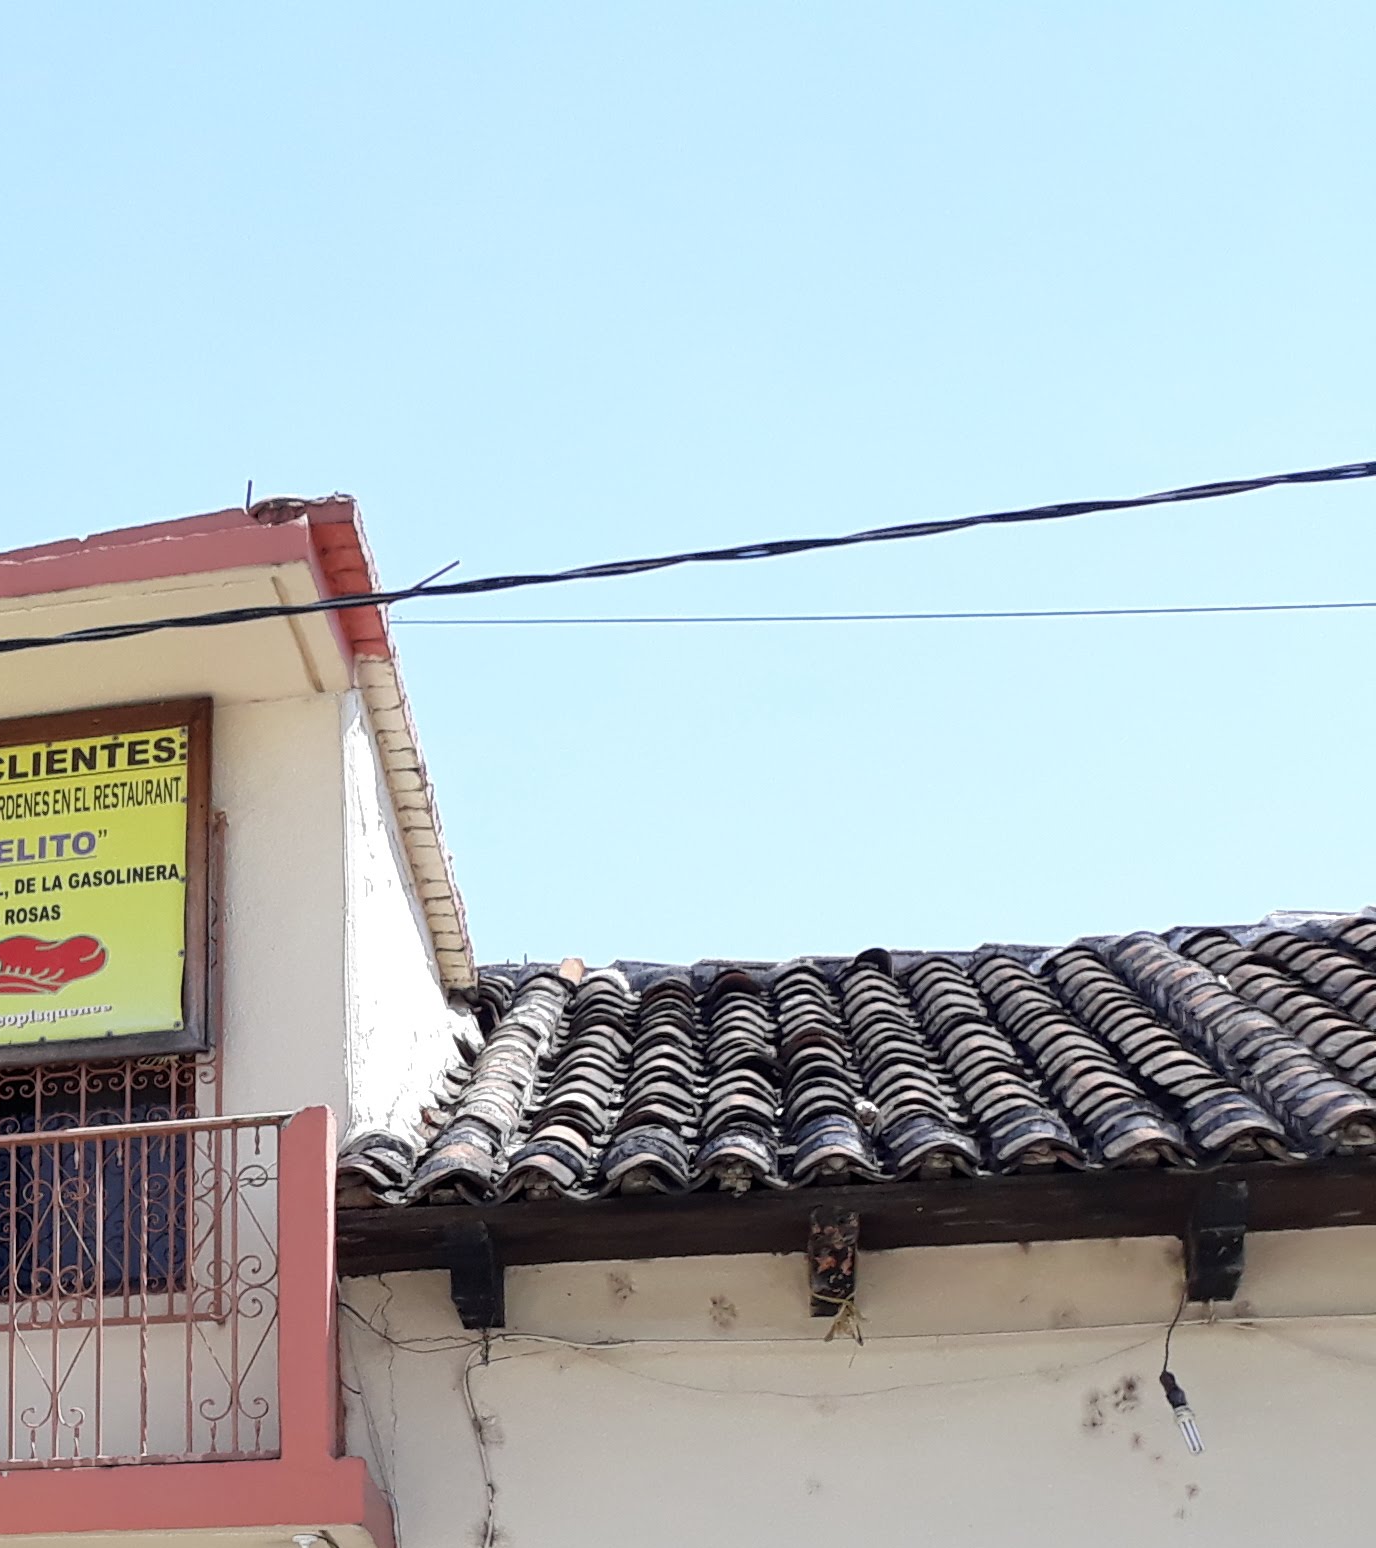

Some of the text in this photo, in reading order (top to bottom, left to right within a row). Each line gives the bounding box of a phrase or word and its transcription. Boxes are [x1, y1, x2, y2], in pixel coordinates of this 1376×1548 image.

[53, 789, 70, 814] EN
[74, 787, 90, 812] EL
[94, 776, 181, 809] RESTAURANT
[15, 877, 35, 895] DE
[42, 875, 62, 891] LA
[5, 904, 61, 925] ROSAS
